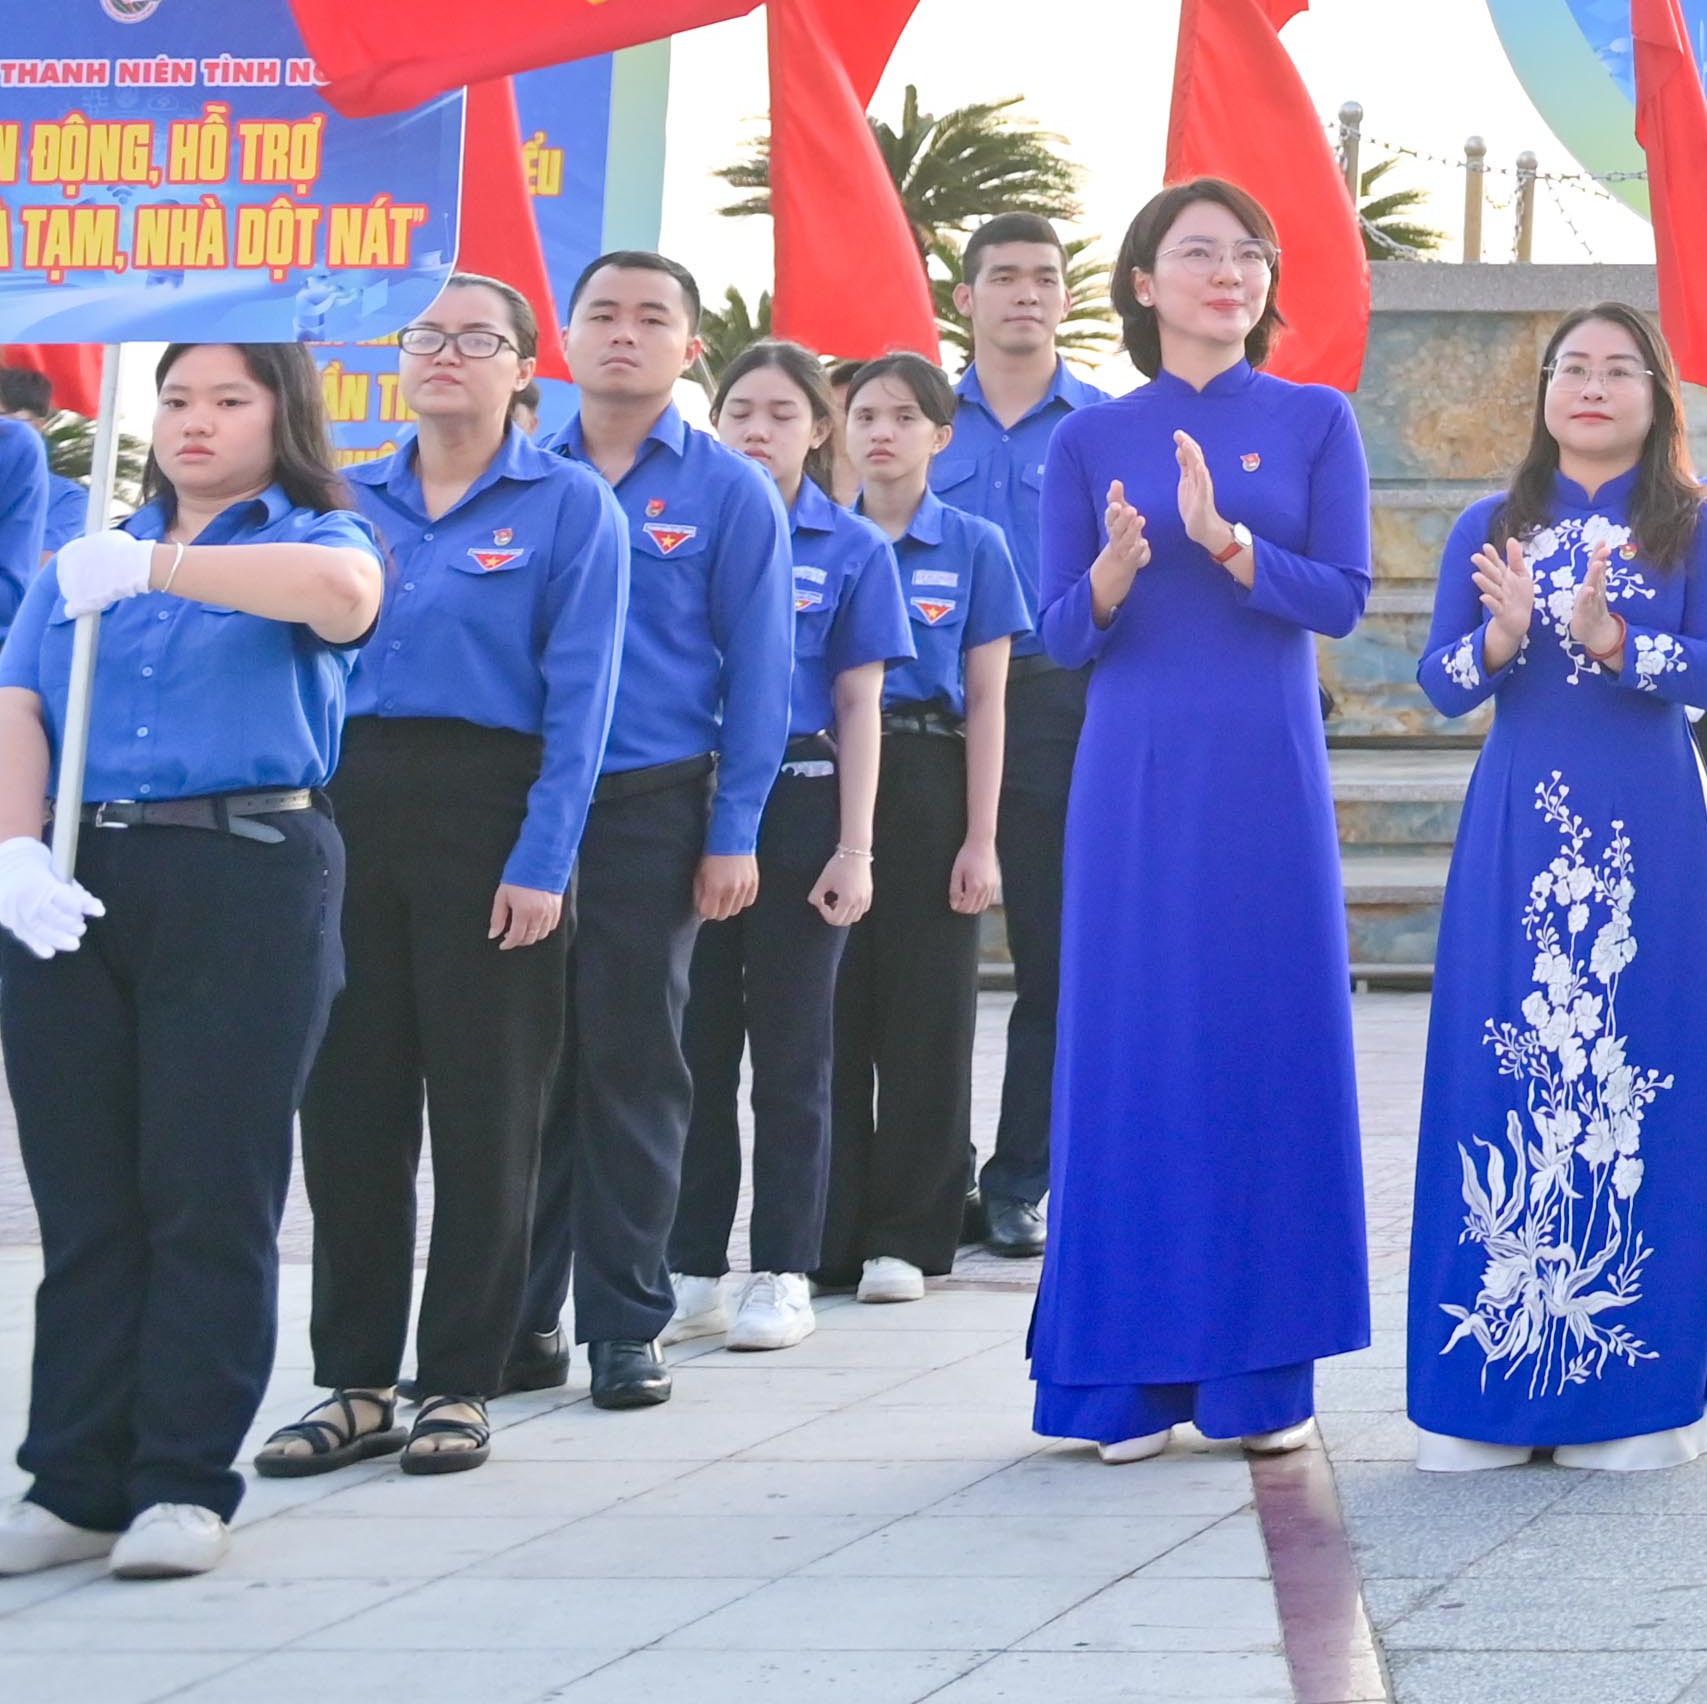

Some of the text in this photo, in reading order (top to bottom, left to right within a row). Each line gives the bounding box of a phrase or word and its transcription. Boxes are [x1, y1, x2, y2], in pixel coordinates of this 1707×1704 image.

[2, 60, 108, 85] THANH
[118, 57, 194, 85] NIÊN
[31, 112, 160, 196] ĐỘNG,
[168, 104, 229, 181] HỖ
[238, 116, 325, 195] TRỢ
[23, 207, 127, 281] TẠM,
[135, 196, 227, 267] NHÀ
[236, 198, 319, 281] DỘT
